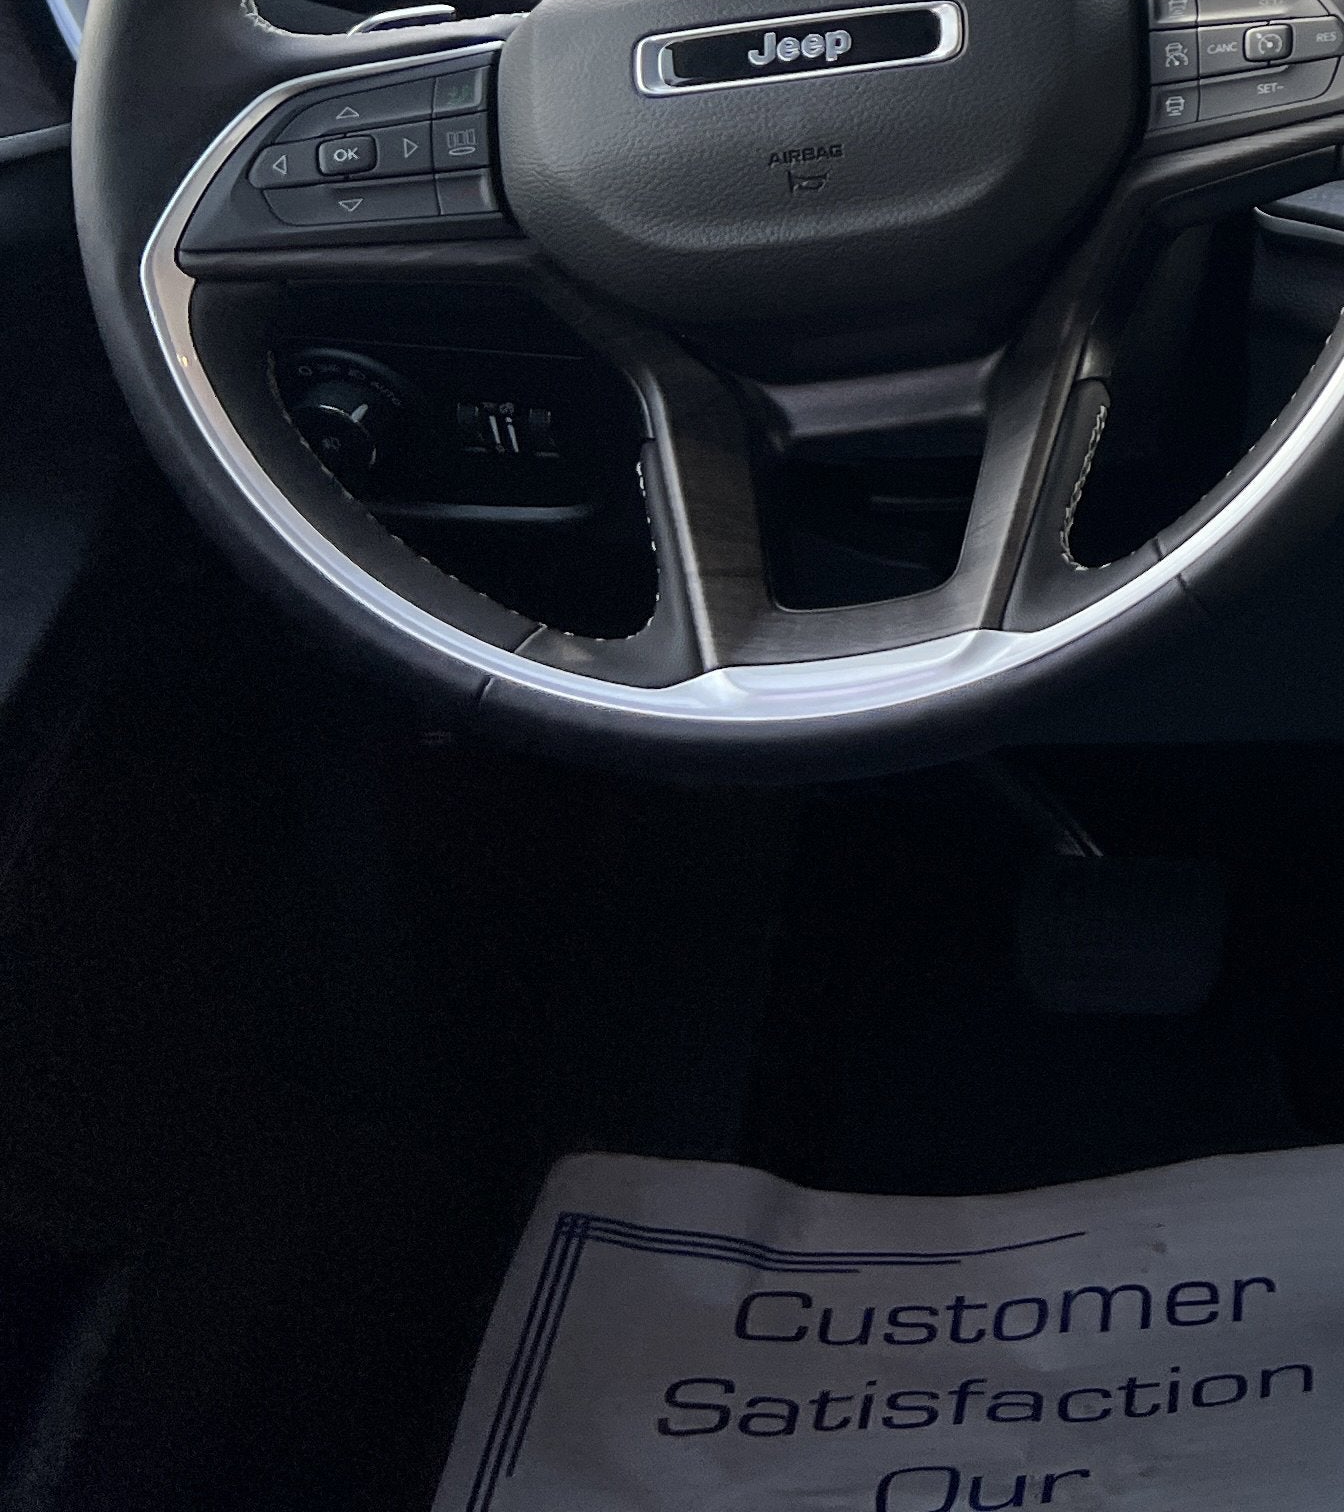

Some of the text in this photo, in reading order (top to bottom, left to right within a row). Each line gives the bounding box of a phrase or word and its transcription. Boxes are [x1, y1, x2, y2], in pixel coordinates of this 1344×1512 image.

[748, 29, 852, 66] Jeep
[1207, 41, 1239, 55] CANC
[1316, 32, 1337, 42] RES
[333, 146, 360, 162] OK
[768, 144, 844, 166] AIRBAG
[734, 1276, 1278, 1346] Customer
[657, 1363, 1315, 1438] Satisfaction
[874, 1465, 1093, 1512] Our
